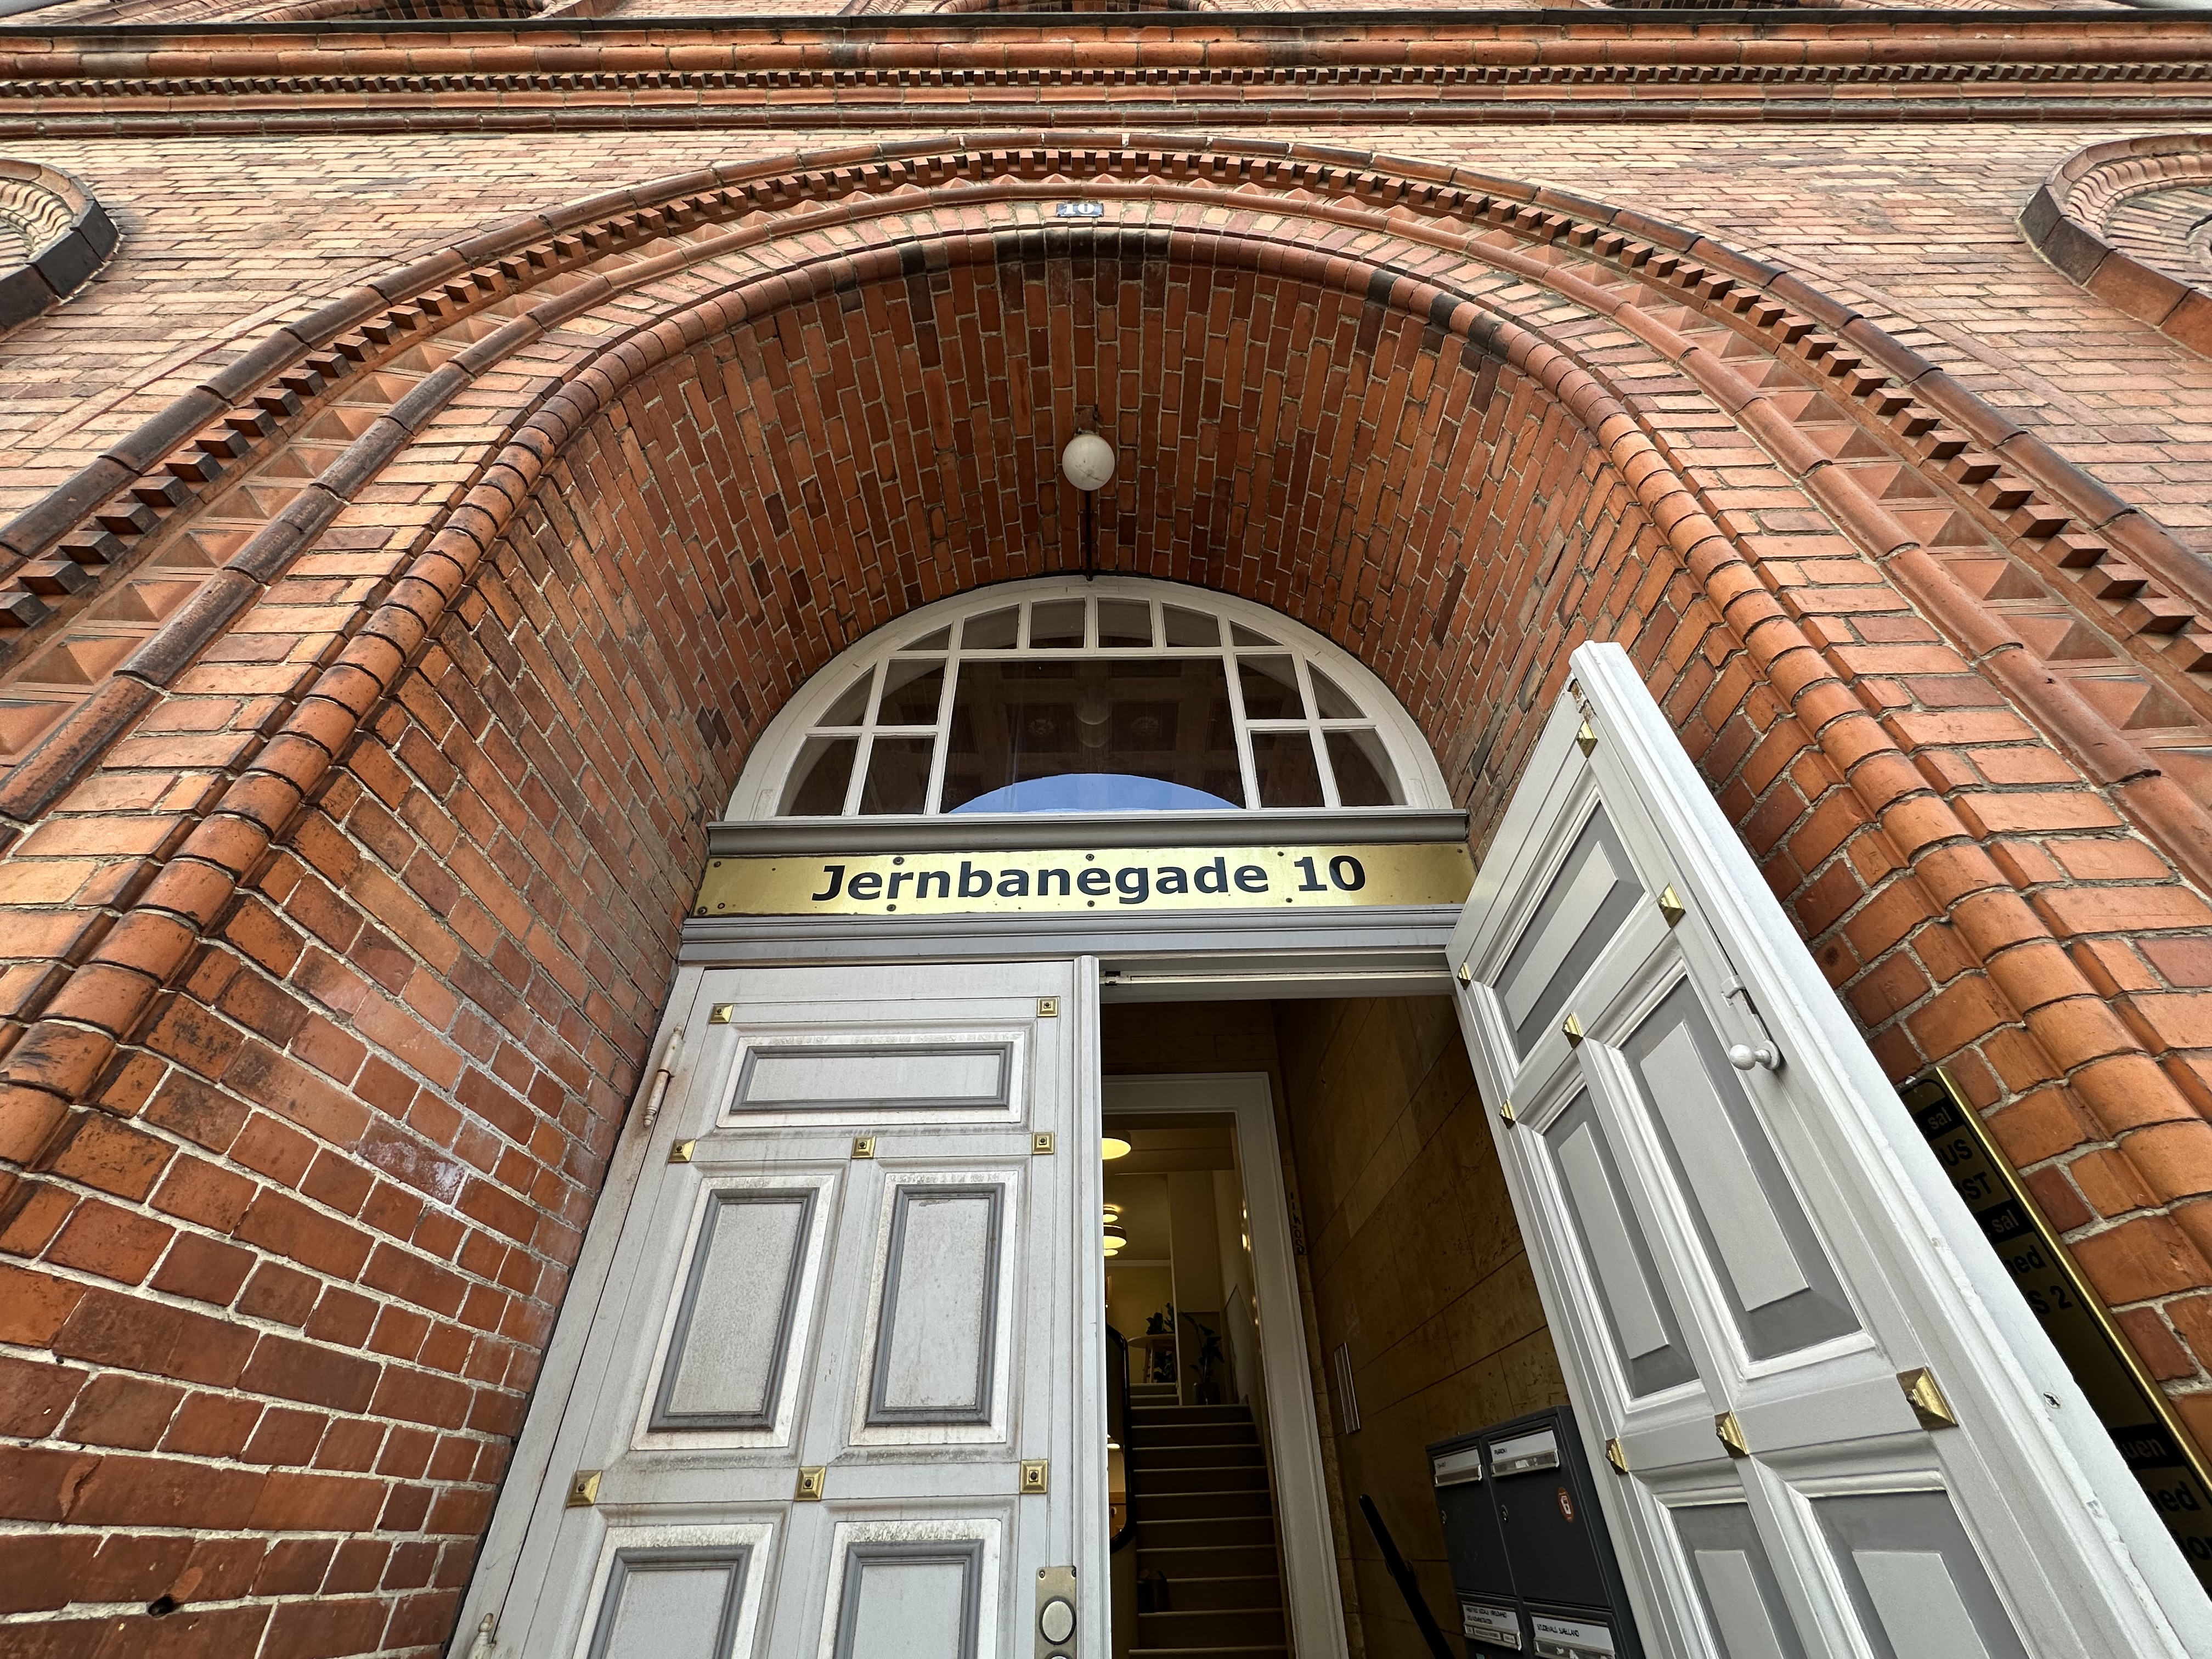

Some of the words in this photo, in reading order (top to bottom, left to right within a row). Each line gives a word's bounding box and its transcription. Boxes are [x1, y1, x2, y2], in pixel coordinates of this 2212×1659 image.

[1063, 203, 1095, 215] 10
[811, 856, 1269, 905] Jernbanegade
[1294, 855, 1366, 891] 10
[1927, 1106, 1952, 1130] sal
[1938, 1139, 1972, 1166] US
[1956, 1171, 1992, 1200] ST
[1991, 1209, 2019, 1233] sal
[2049, 1285, 2074, 1310] 2
